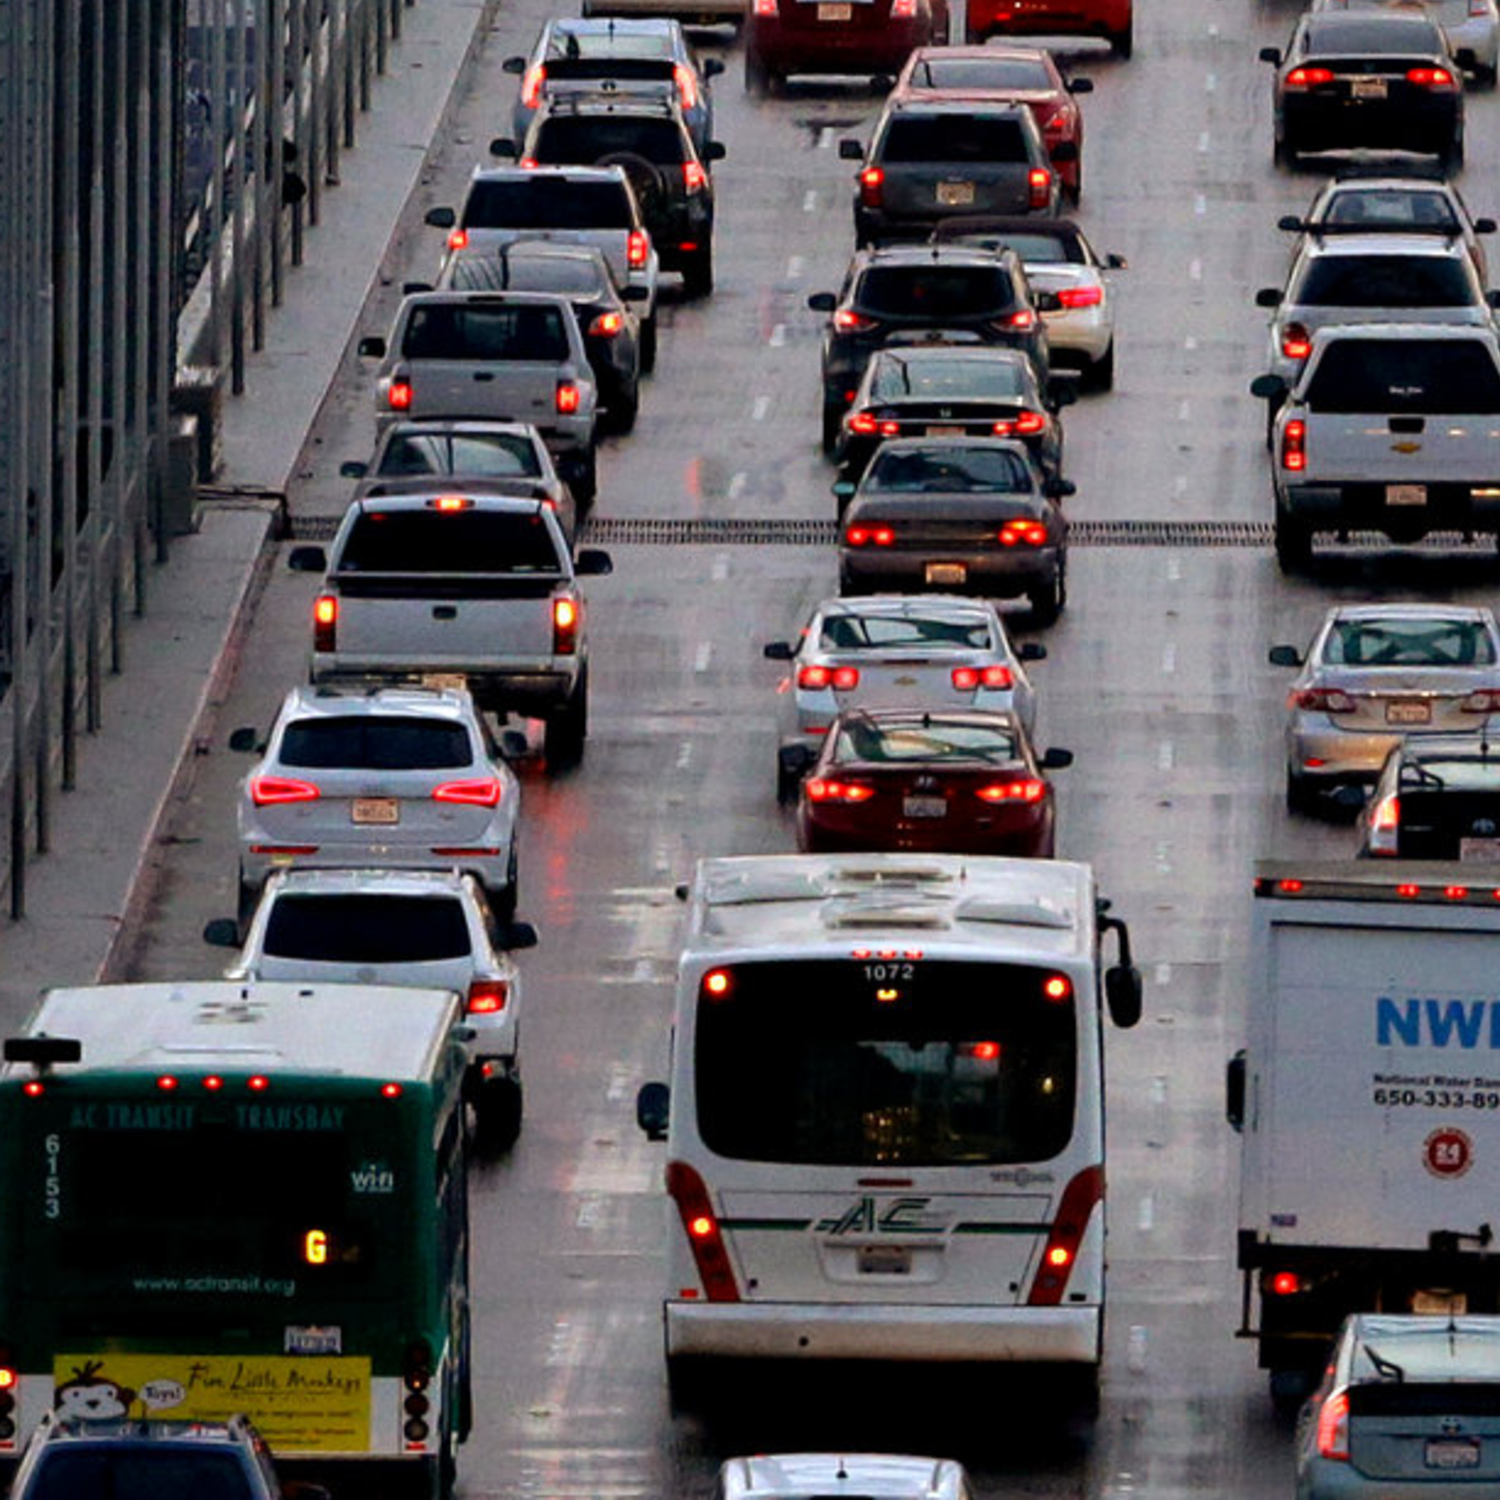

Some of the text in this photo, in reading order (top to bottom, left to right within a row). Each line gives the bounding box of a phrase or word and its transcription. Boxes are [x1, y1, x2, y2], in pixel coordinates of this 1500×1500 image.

[863, 963, 914, 981] 1072
[1373, 1074, 1430, 1086] National
[1433, 1076, 1471, 1087] Water
[70, 1105, 345, 1131] AC TRANSIT TRANSBAY
[306, 1230, 327, 1264] G
[132, 1276, 296, 1297] www.actransit.org
